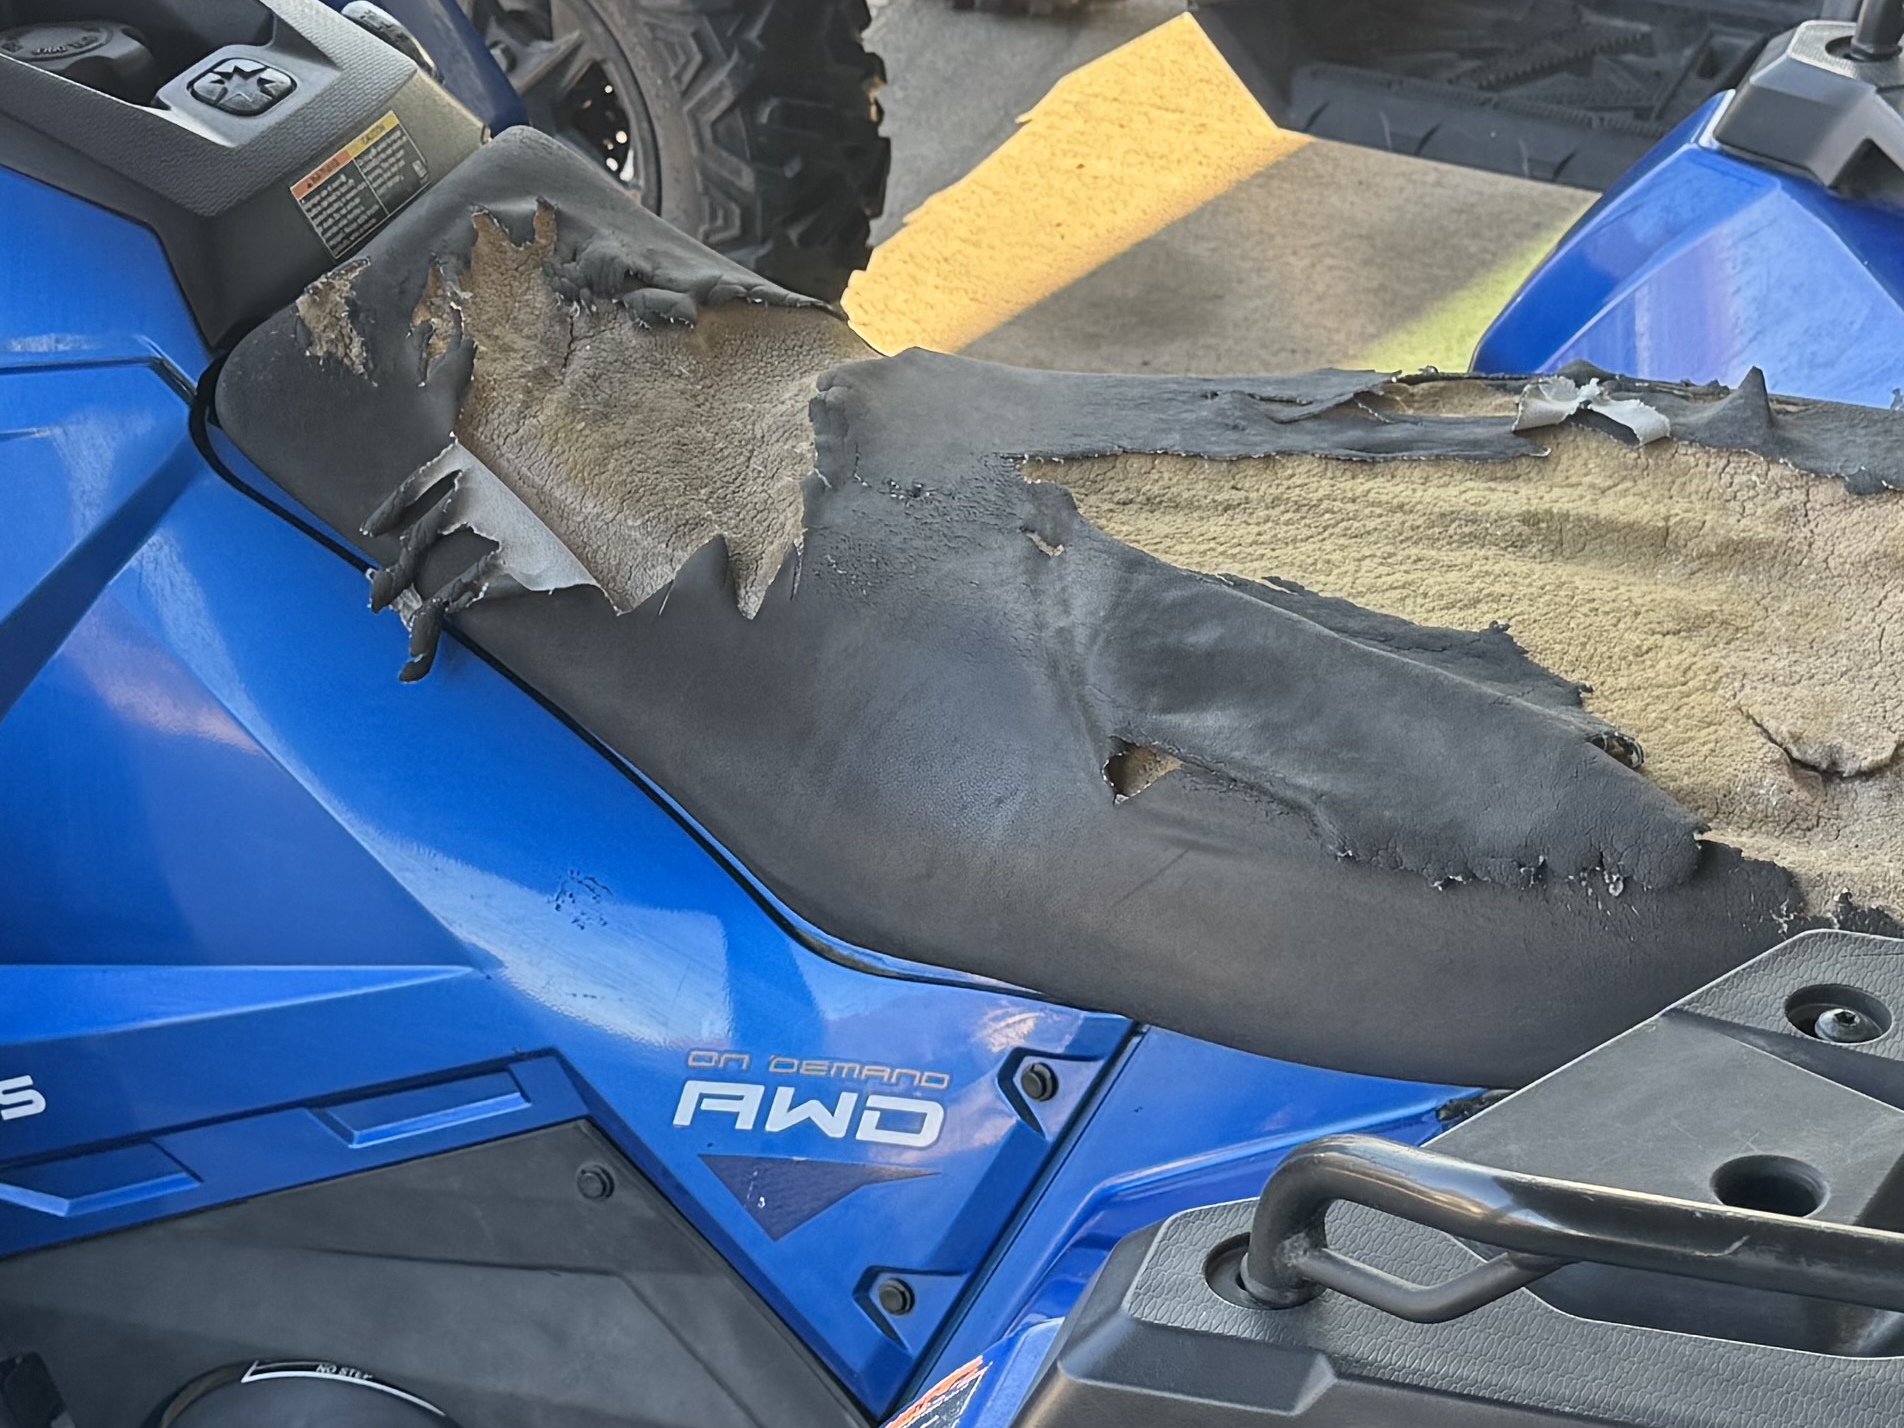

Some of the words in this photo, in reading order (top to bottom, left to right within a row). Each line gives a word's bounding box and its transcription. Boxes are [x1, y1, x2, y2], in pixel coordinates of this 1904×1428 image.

[687, 1050, 751, 1070] ON
[768, 1054, 950, 1089] DEMAND
[673, 1080, 945, 1147] AWD
